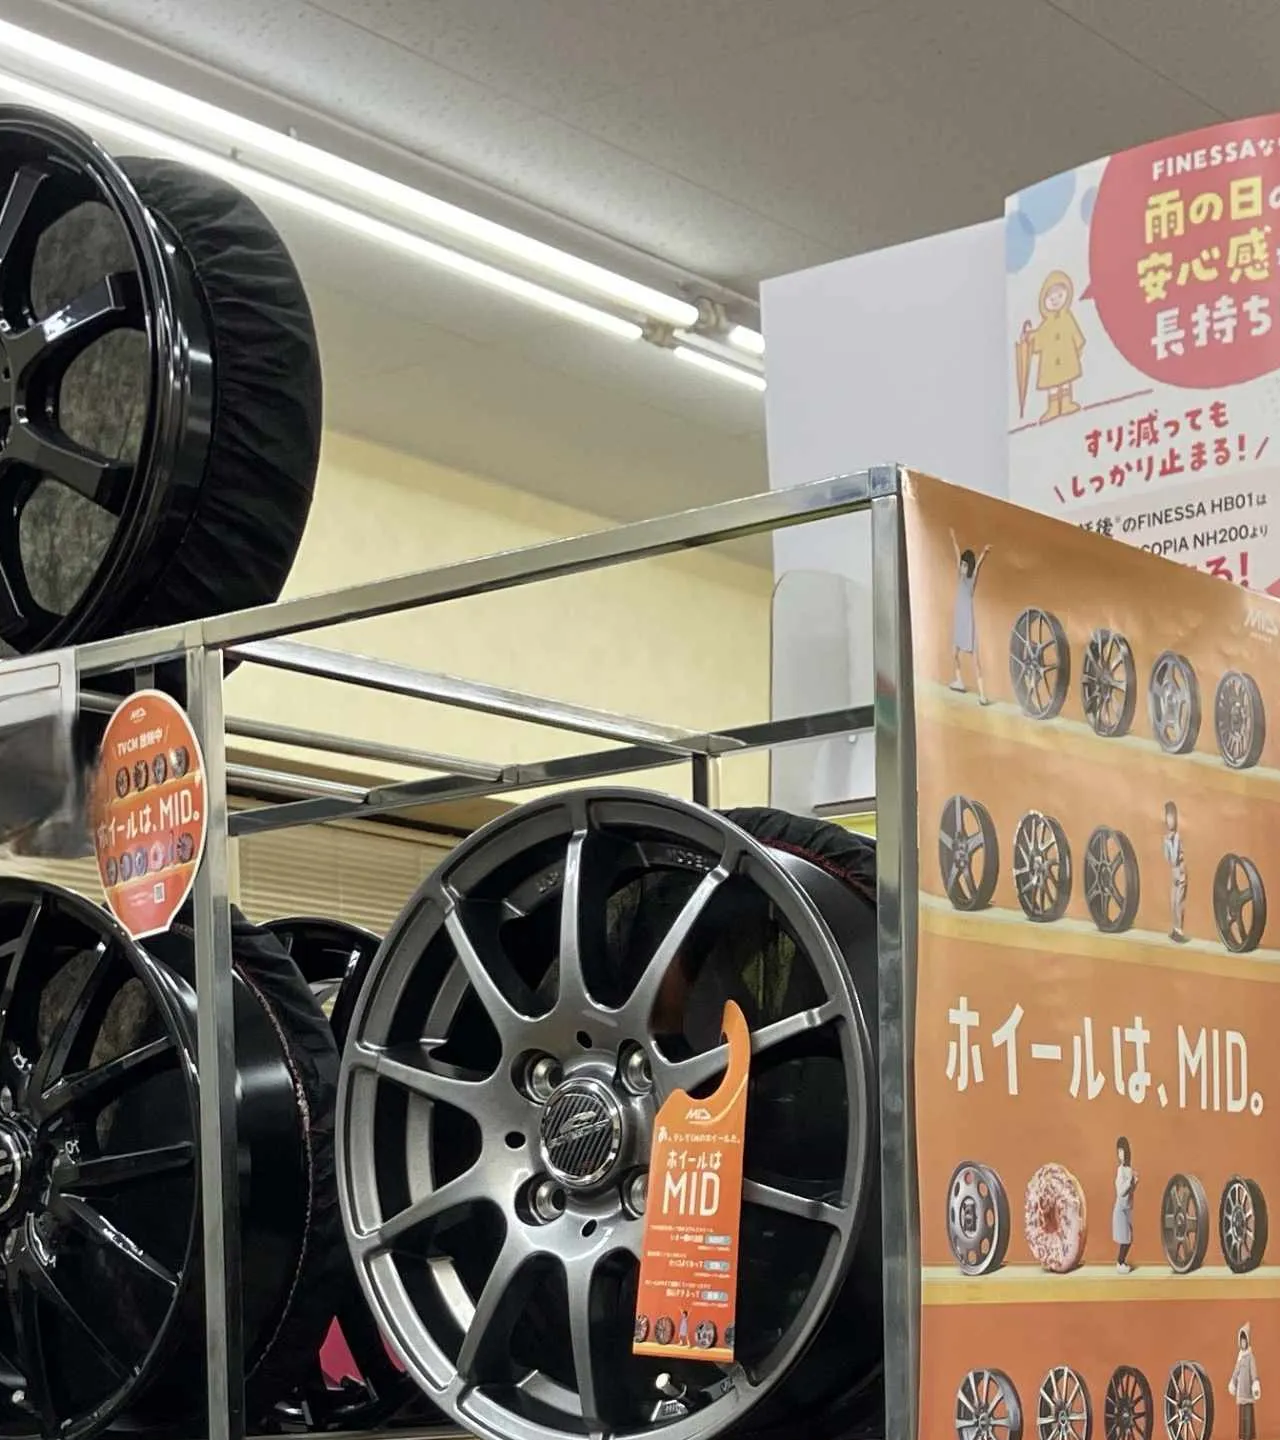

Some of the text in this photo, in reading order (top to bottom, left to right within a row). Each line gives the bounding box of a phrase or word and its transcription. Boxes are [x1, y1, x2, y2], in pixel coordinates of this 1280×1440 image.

[1084, 400, 1230, 458] すり減っても
[1192, 524, 1270, 550] NH200より
[944, 995, 1265, 1117] ホイールは、MID。
[666, 1148, 723, 1171] ホイールは
[662, 1170, 721, 1217] MID
